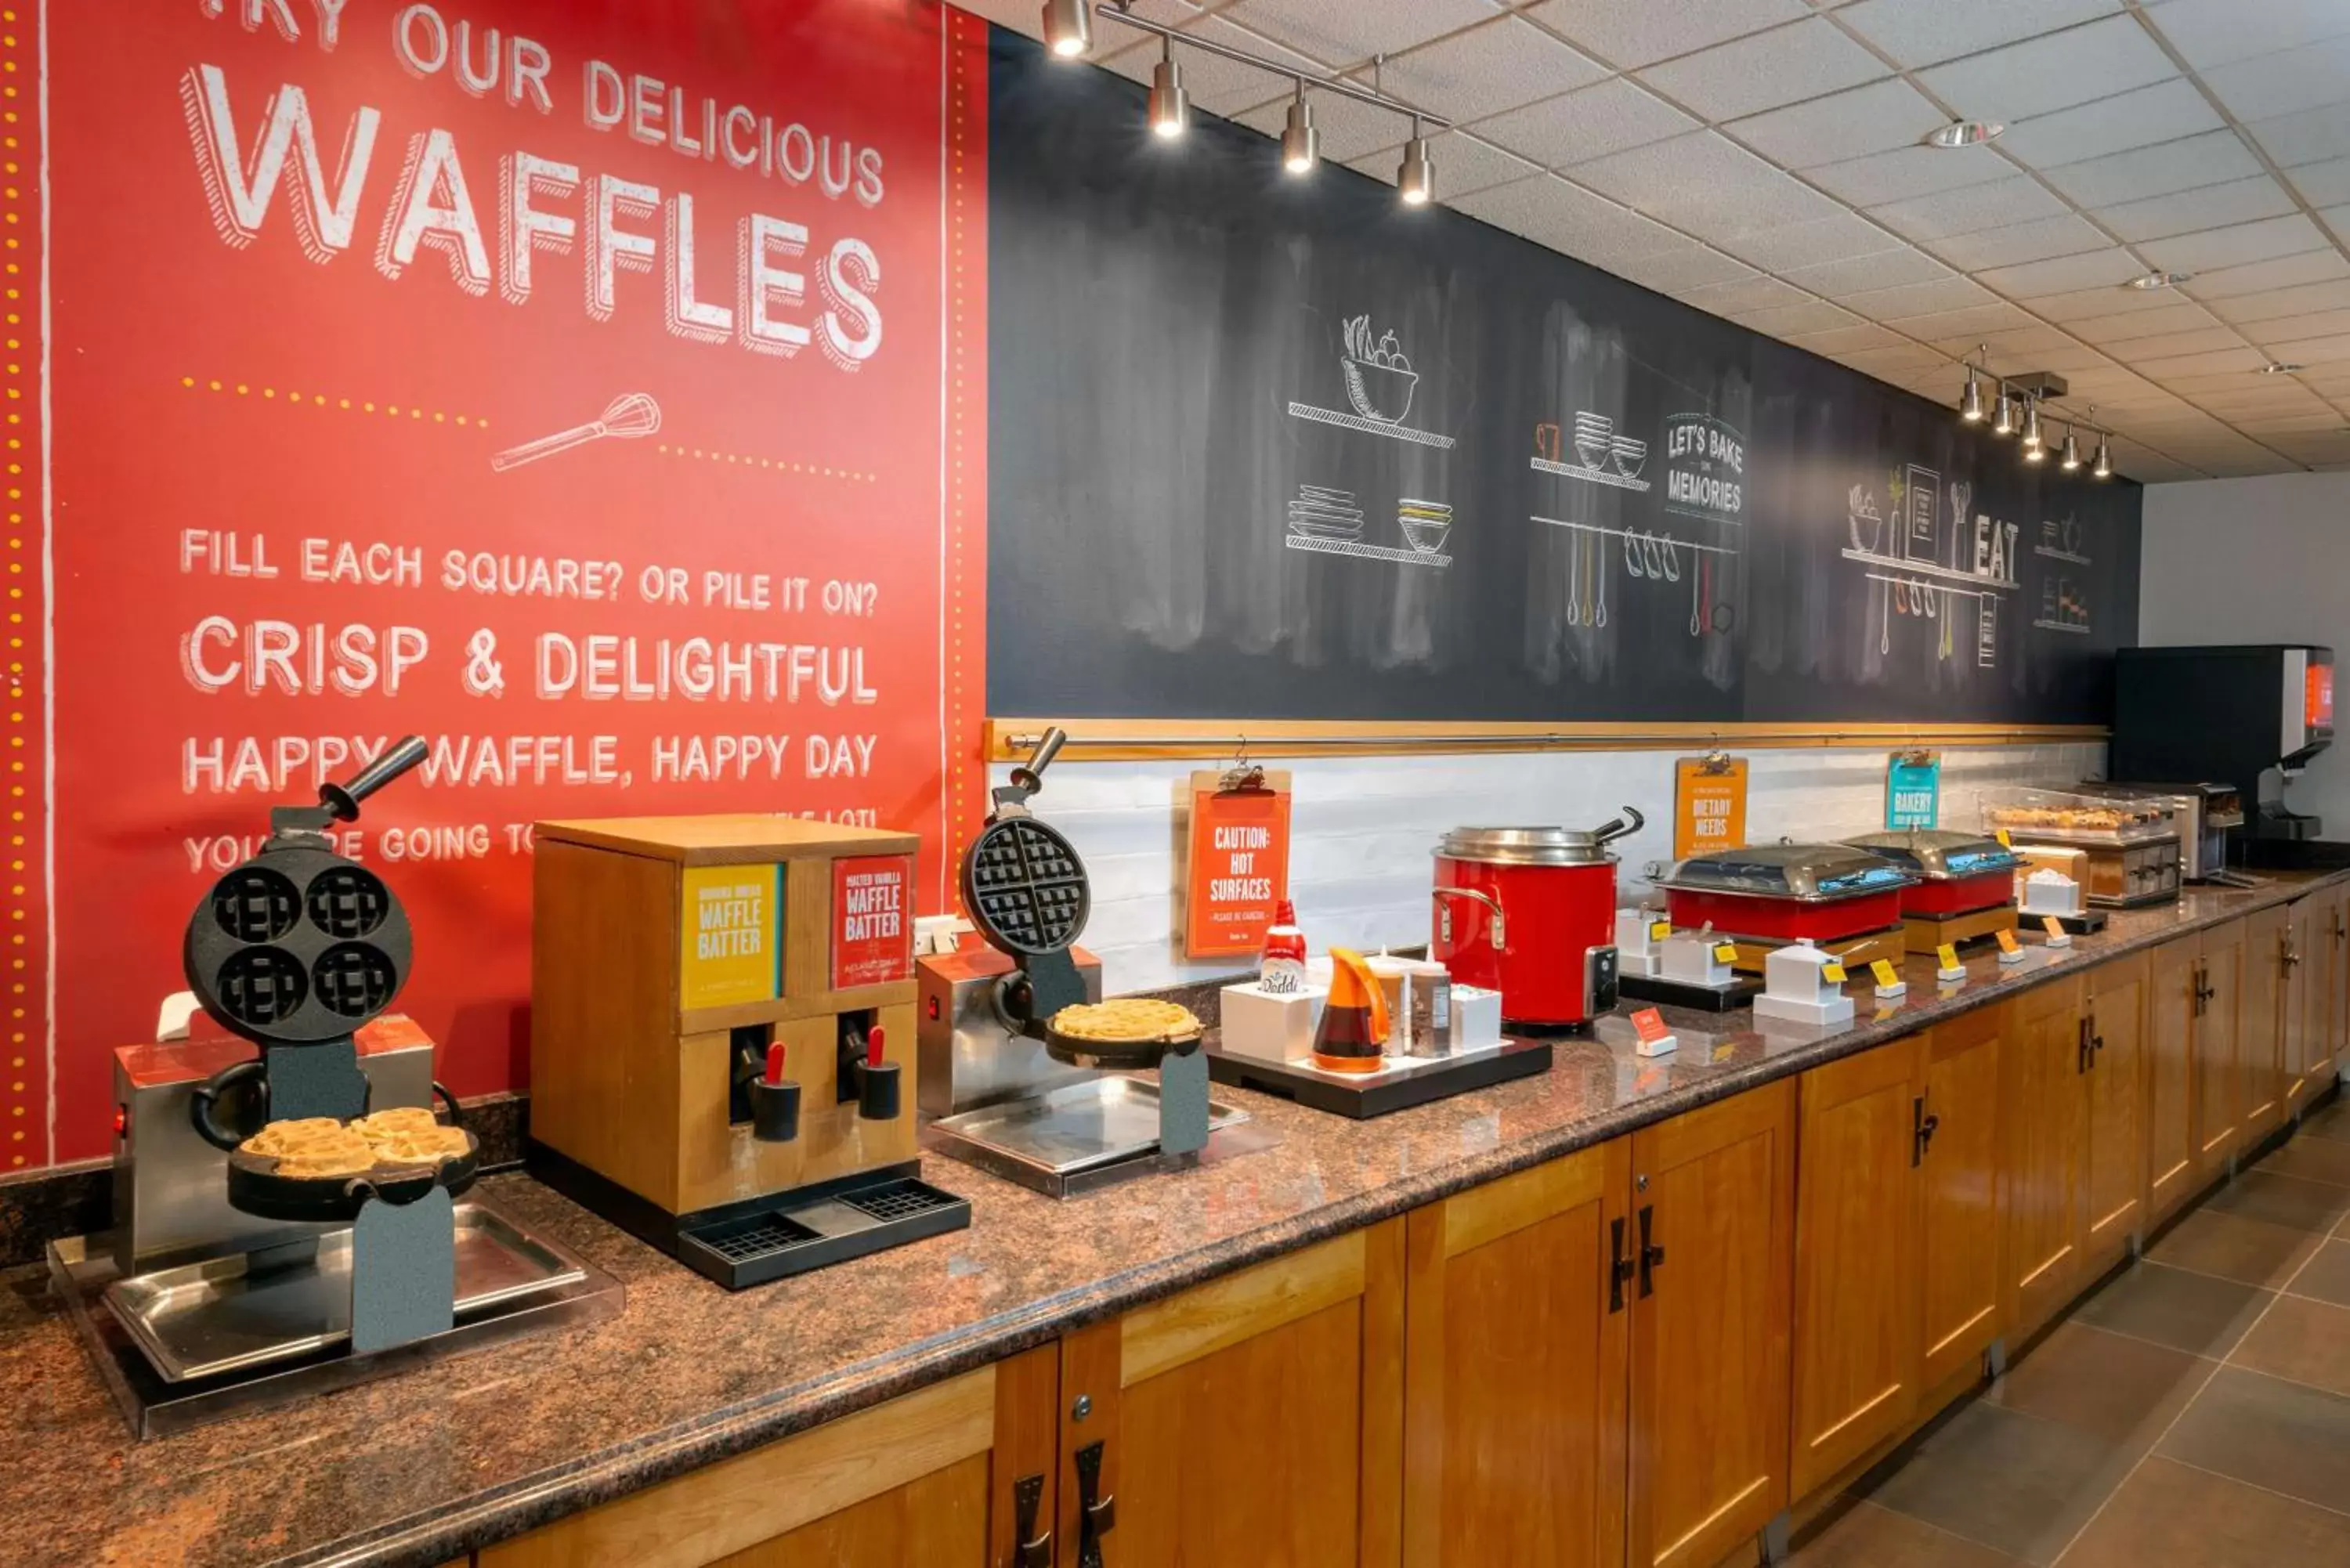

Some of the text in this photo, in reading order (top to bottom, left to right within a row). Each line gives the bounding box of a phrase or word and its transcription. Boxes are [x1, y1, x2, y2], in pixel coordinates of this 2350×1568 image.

[393, 4, 884, 208] OUR DELICIOUS
[179, 63, 883, 372] WAFFLES
[1668, 424, 1743, 475] LET'S BAKE
[1668, 469, 1741, 513] MEMORIES
[1974, 514, 2019, 581] EAT
[180, 528, 878, 617] FILL EACH SQUARE? OR PILE IT ON?
[179, 615, 878, 706] CRISP & DELIGHTFUL
[416, 735, 632, 789] WAFFLE,
[651, 735, 789, 782] HAPPY
[805, 734, 877, 780] DAY
[1894, 792, 1932, 813] BAKERY
[379, 826, 490, 860] GOING
[1215, 826, 1271, 850] CAUTION:
[1696, 818, 1727, 836] NEEDS
[1231, 853, 1253, 875] HOT
[846, 884, 900, 915] WAFFLE
[1210, 878, 1271, 901] SURFACES
[699, 898, 762, 930] WAFFLE
[845, 912, 900, 941] BATTER
[698, 927, 761, 960] BATTER
